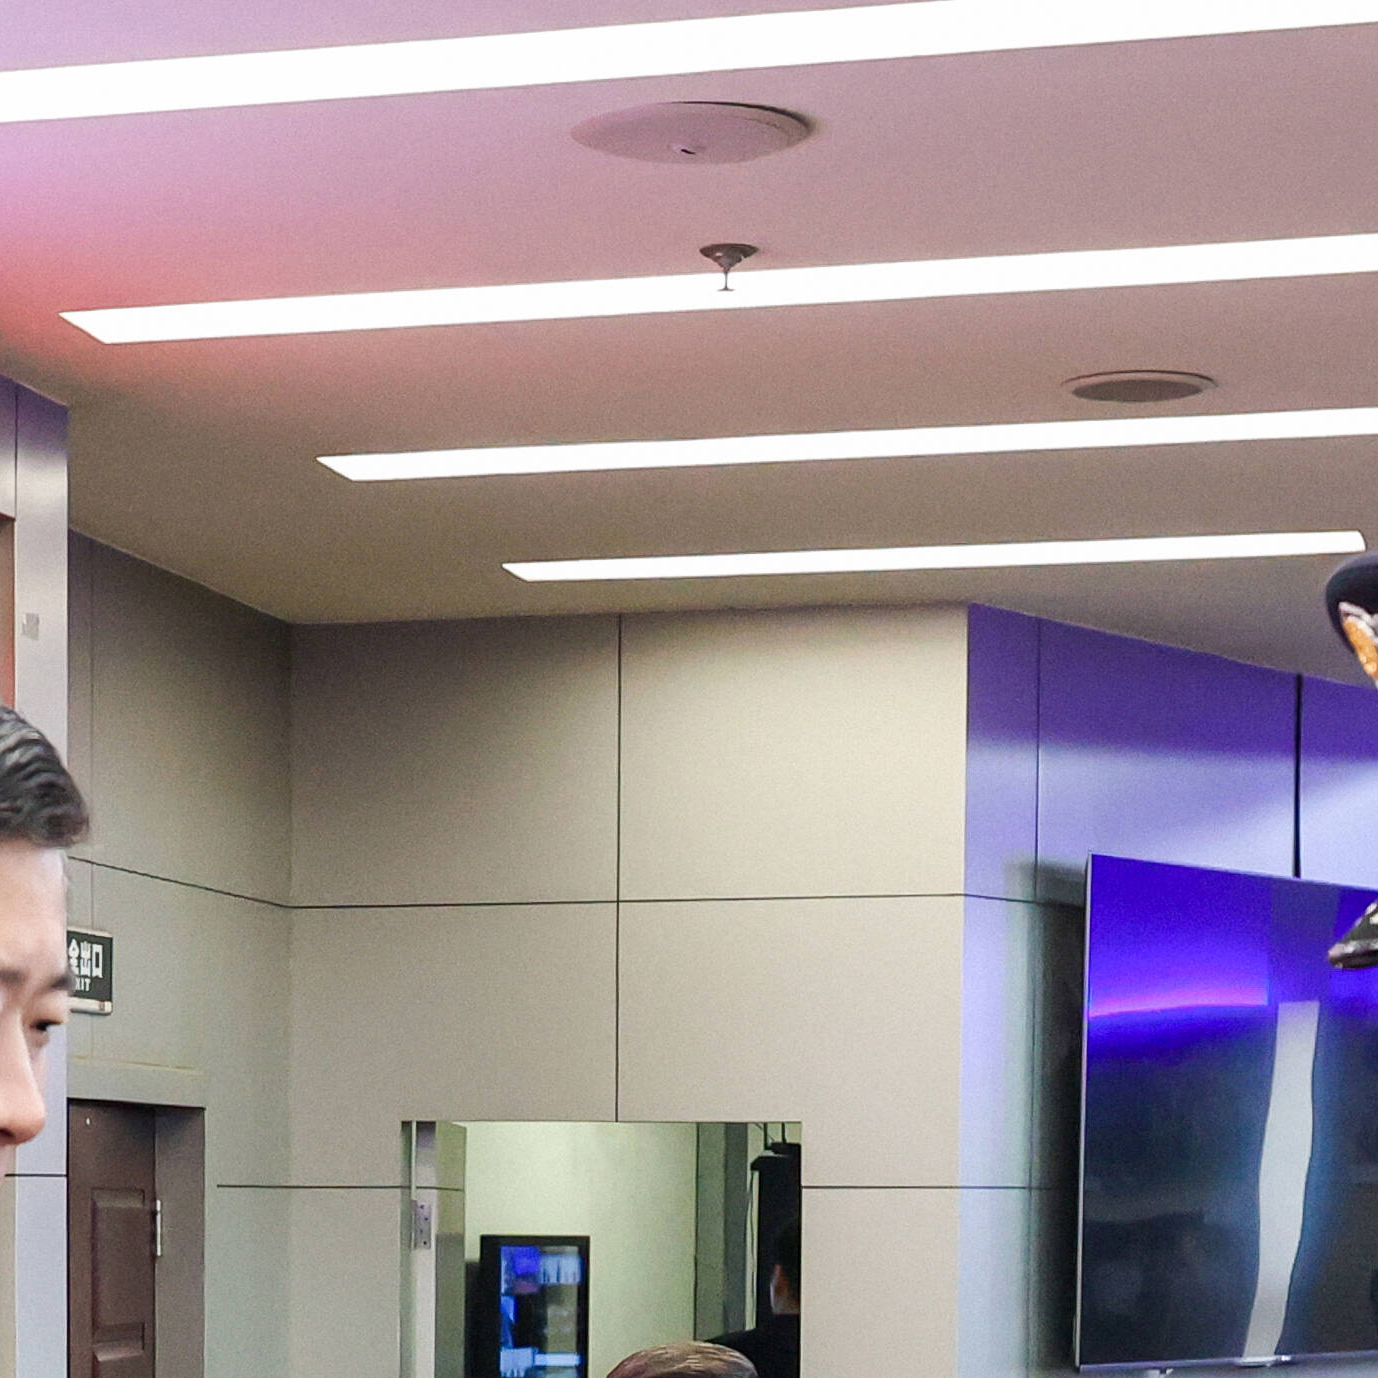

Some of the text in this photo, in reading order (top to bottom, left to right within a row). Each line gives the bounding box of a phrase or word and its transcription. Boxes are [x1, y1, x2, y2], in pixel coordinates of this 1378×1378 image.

[68, 938, 104, 979] 全出口
[75, 977, 91, 992] XIT
